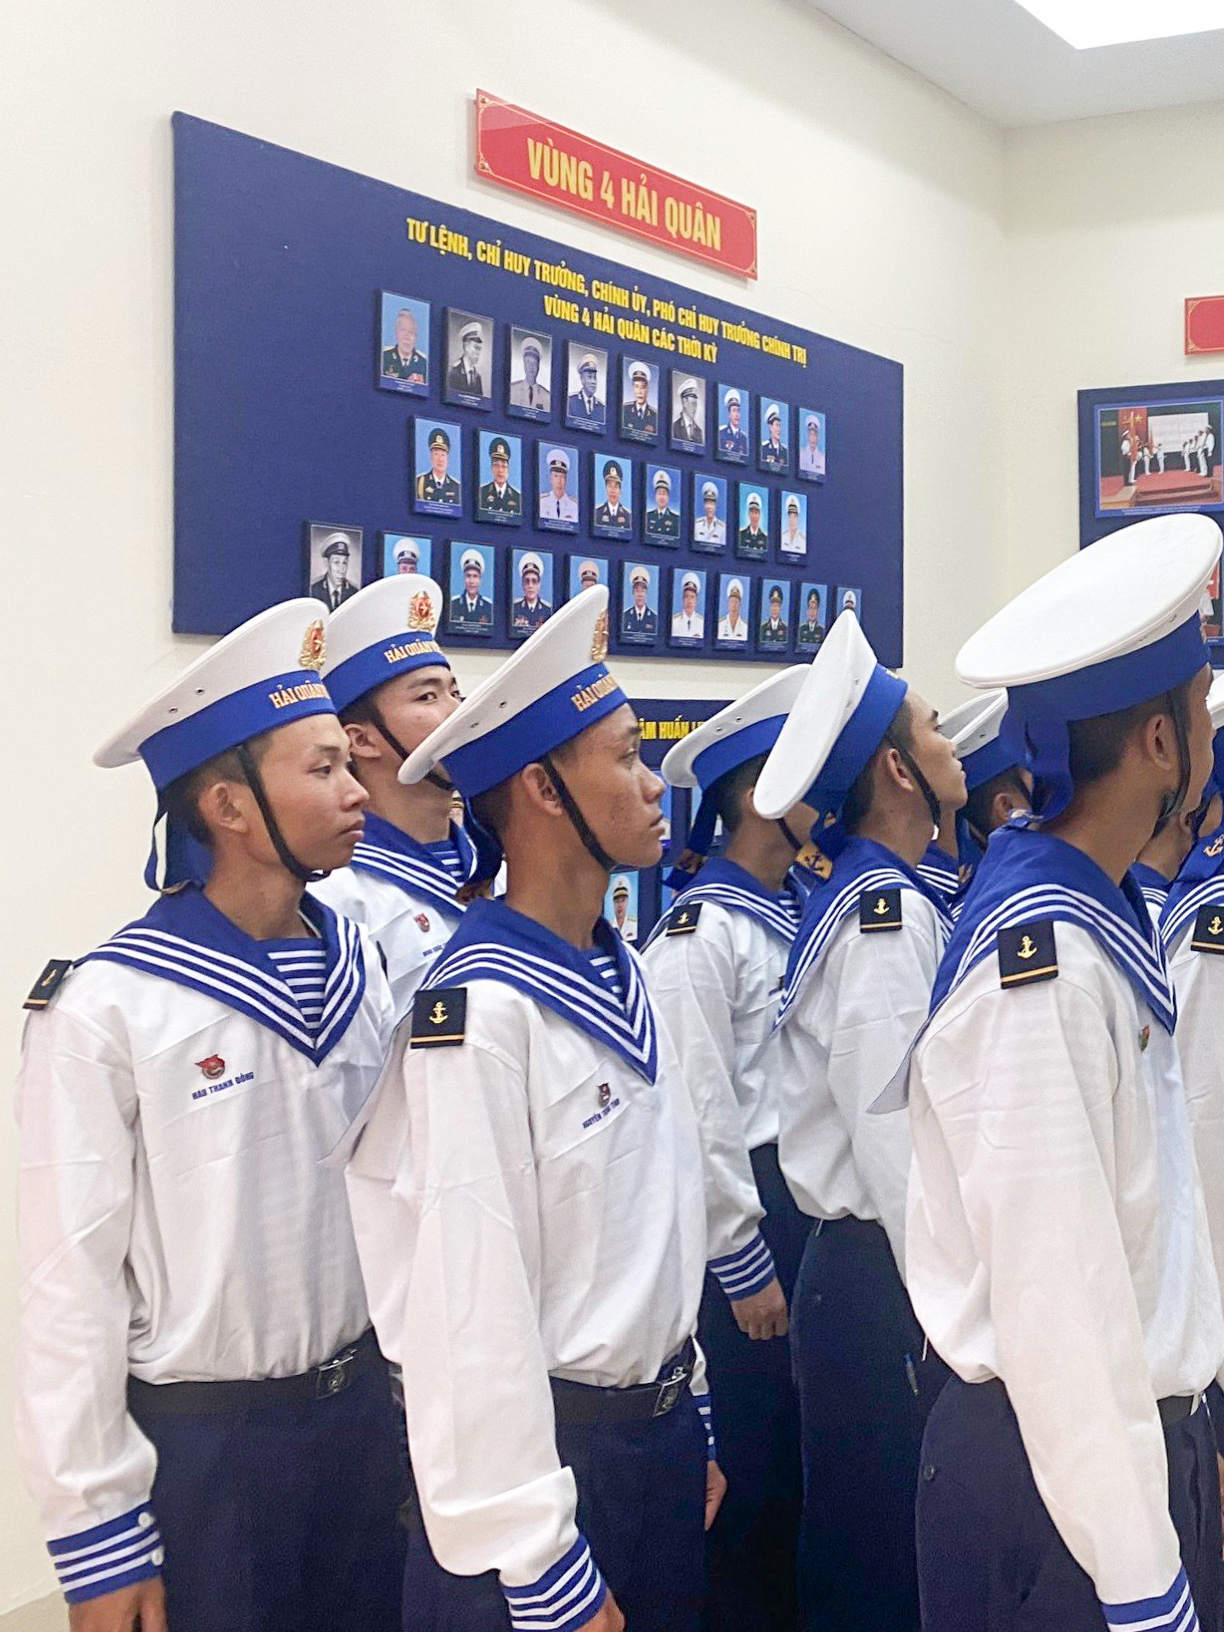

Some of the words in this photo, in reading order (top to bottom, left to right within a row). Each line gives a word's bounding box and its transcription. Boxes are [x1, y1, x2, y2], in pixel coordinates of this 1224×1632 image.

[527, 138, 593, 201] VÙNG
[600, 171, 615, 209] 4
[621, 173, 658, 226] HẢI
[664, 197, 721, 251] QUÂN
[406, 217, 429, 243] TƯ
[429, 224, 472, 260] LỆNH,
[476, 239, 501, 267] CHỈ
[504, 249, 531, 277] HUY
[534, 260, 589, 297] TRƯỞNG,
[591, 280, 630, 309] CHÍNH
[652, 298, 675, 323] PHÓ
[678, 305, 697, 328] CHỈ
[698, 313, 719, 336] HUY
[721, 320, 760, 350] TRƯỞNG
[762, 335, 791, 361] CHÍNH
[791, 345, 808, 369] TRỊ
[543, 294, 580, 324] VÙNG
[582, 307, 591, 327] 4
[593, 306, 615, 335] HẢI
[617, 318, 650, 345] QUÂN
[652, 327, 675, 352] CÁC
[677, 336, 702, 360] THỜI
[702, 342, 718, 364] KỲ
[269, 684, 299, 709] HẢI
[639, 718, 656, 740] ÂM
